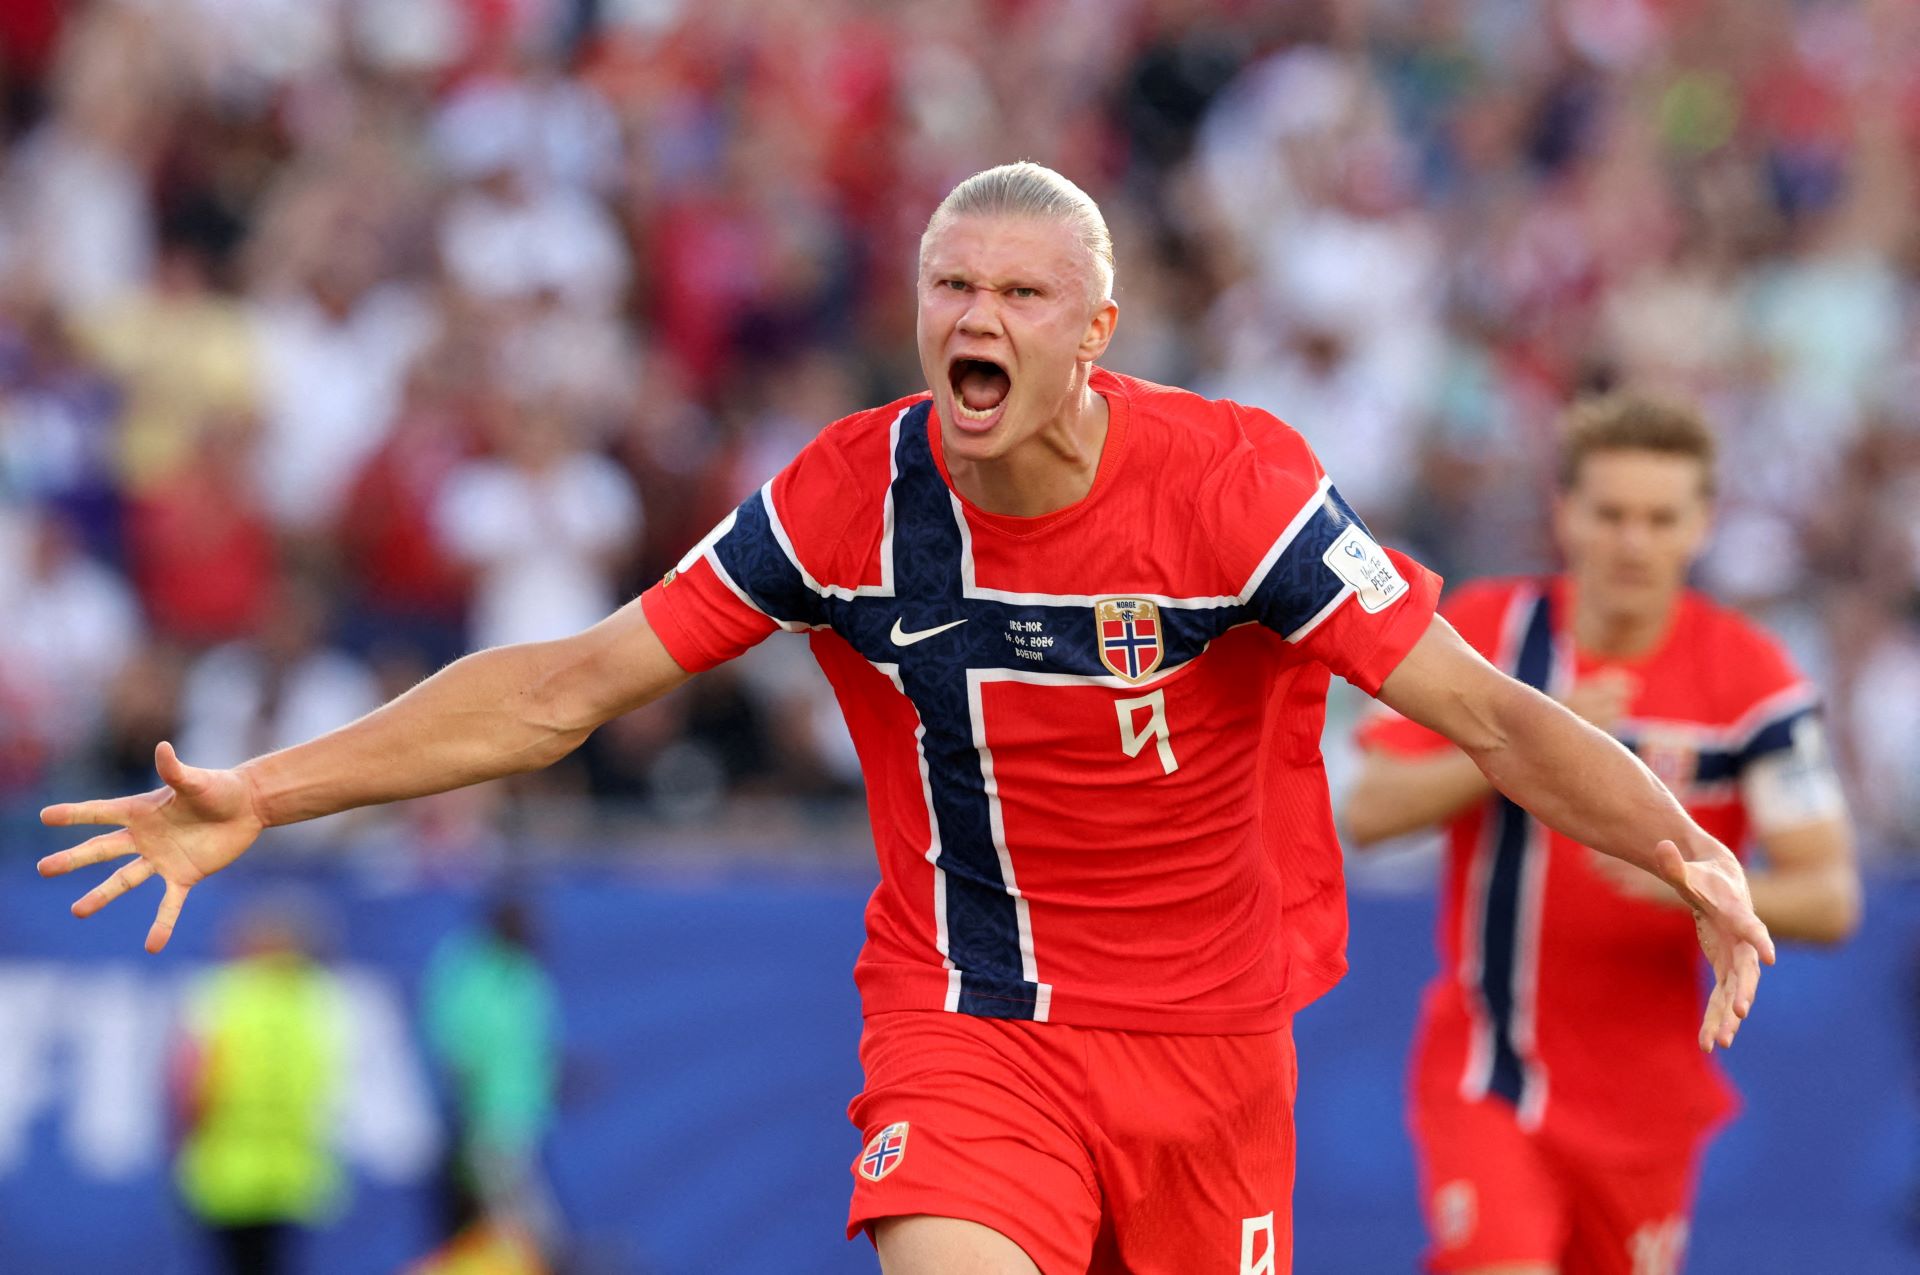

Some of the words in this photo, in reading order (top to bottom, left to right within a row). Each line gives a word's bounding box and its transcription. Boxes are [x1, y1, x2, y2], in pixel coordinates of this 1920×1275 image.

[1370, 567, 1393, 591] PEACE
[1010, 620, 1043, 633] IRQ-NOR
[1015, 647, 1043, 661] BOSTON
[1113, 687, 1180, 776] 9
